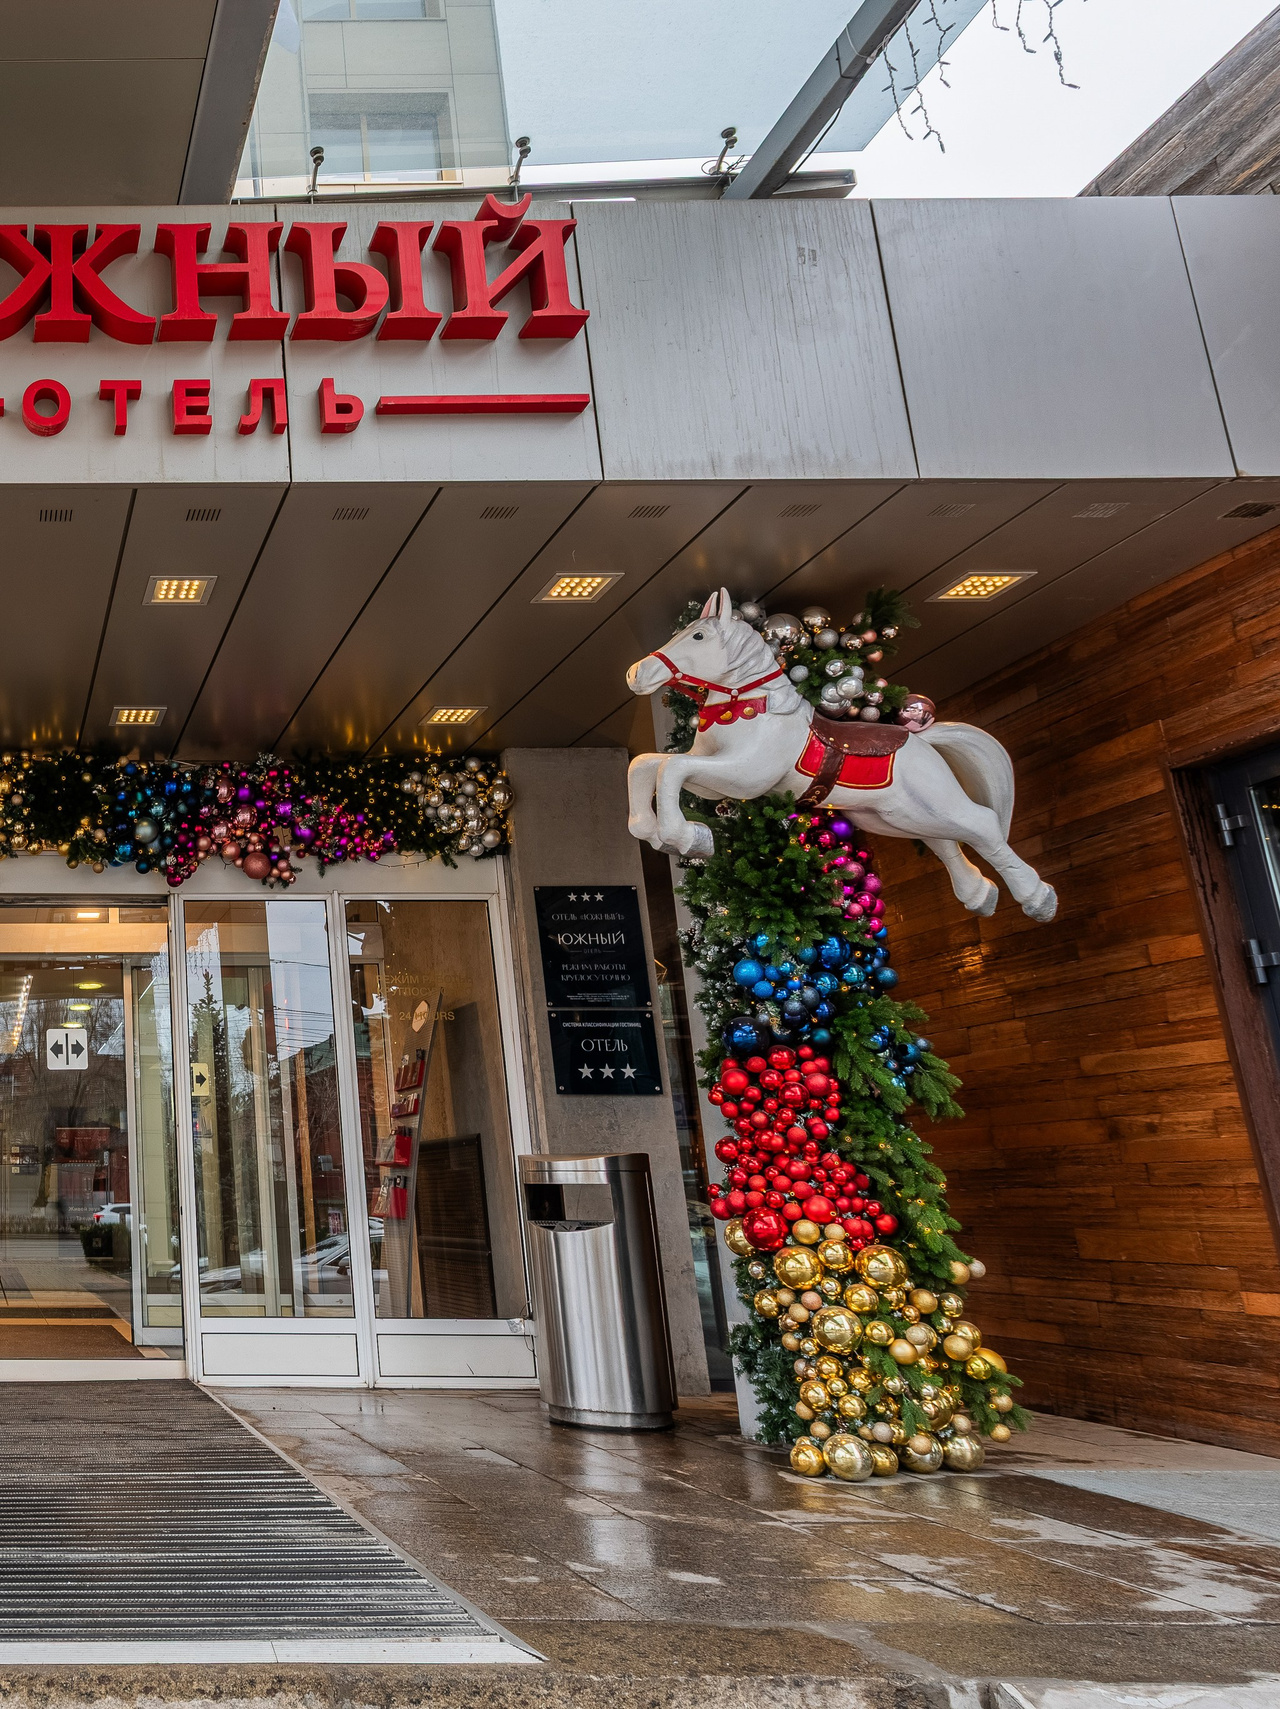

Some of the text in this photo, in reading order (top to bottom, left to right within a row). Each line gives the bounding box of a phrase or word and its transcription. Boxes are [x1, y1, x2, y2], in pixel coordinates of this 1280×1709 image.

[21, 377, 365, 437] ОТЕЛЬ
[551, 913, 578, 921] ОТЕЛЬ
[557, 930, 626, 946] ЮЖНЫЙ
[399, 1011, 456, 1021] 24 HOURS
[581, 1038, 628, 1052] ОТЕЛЬ
